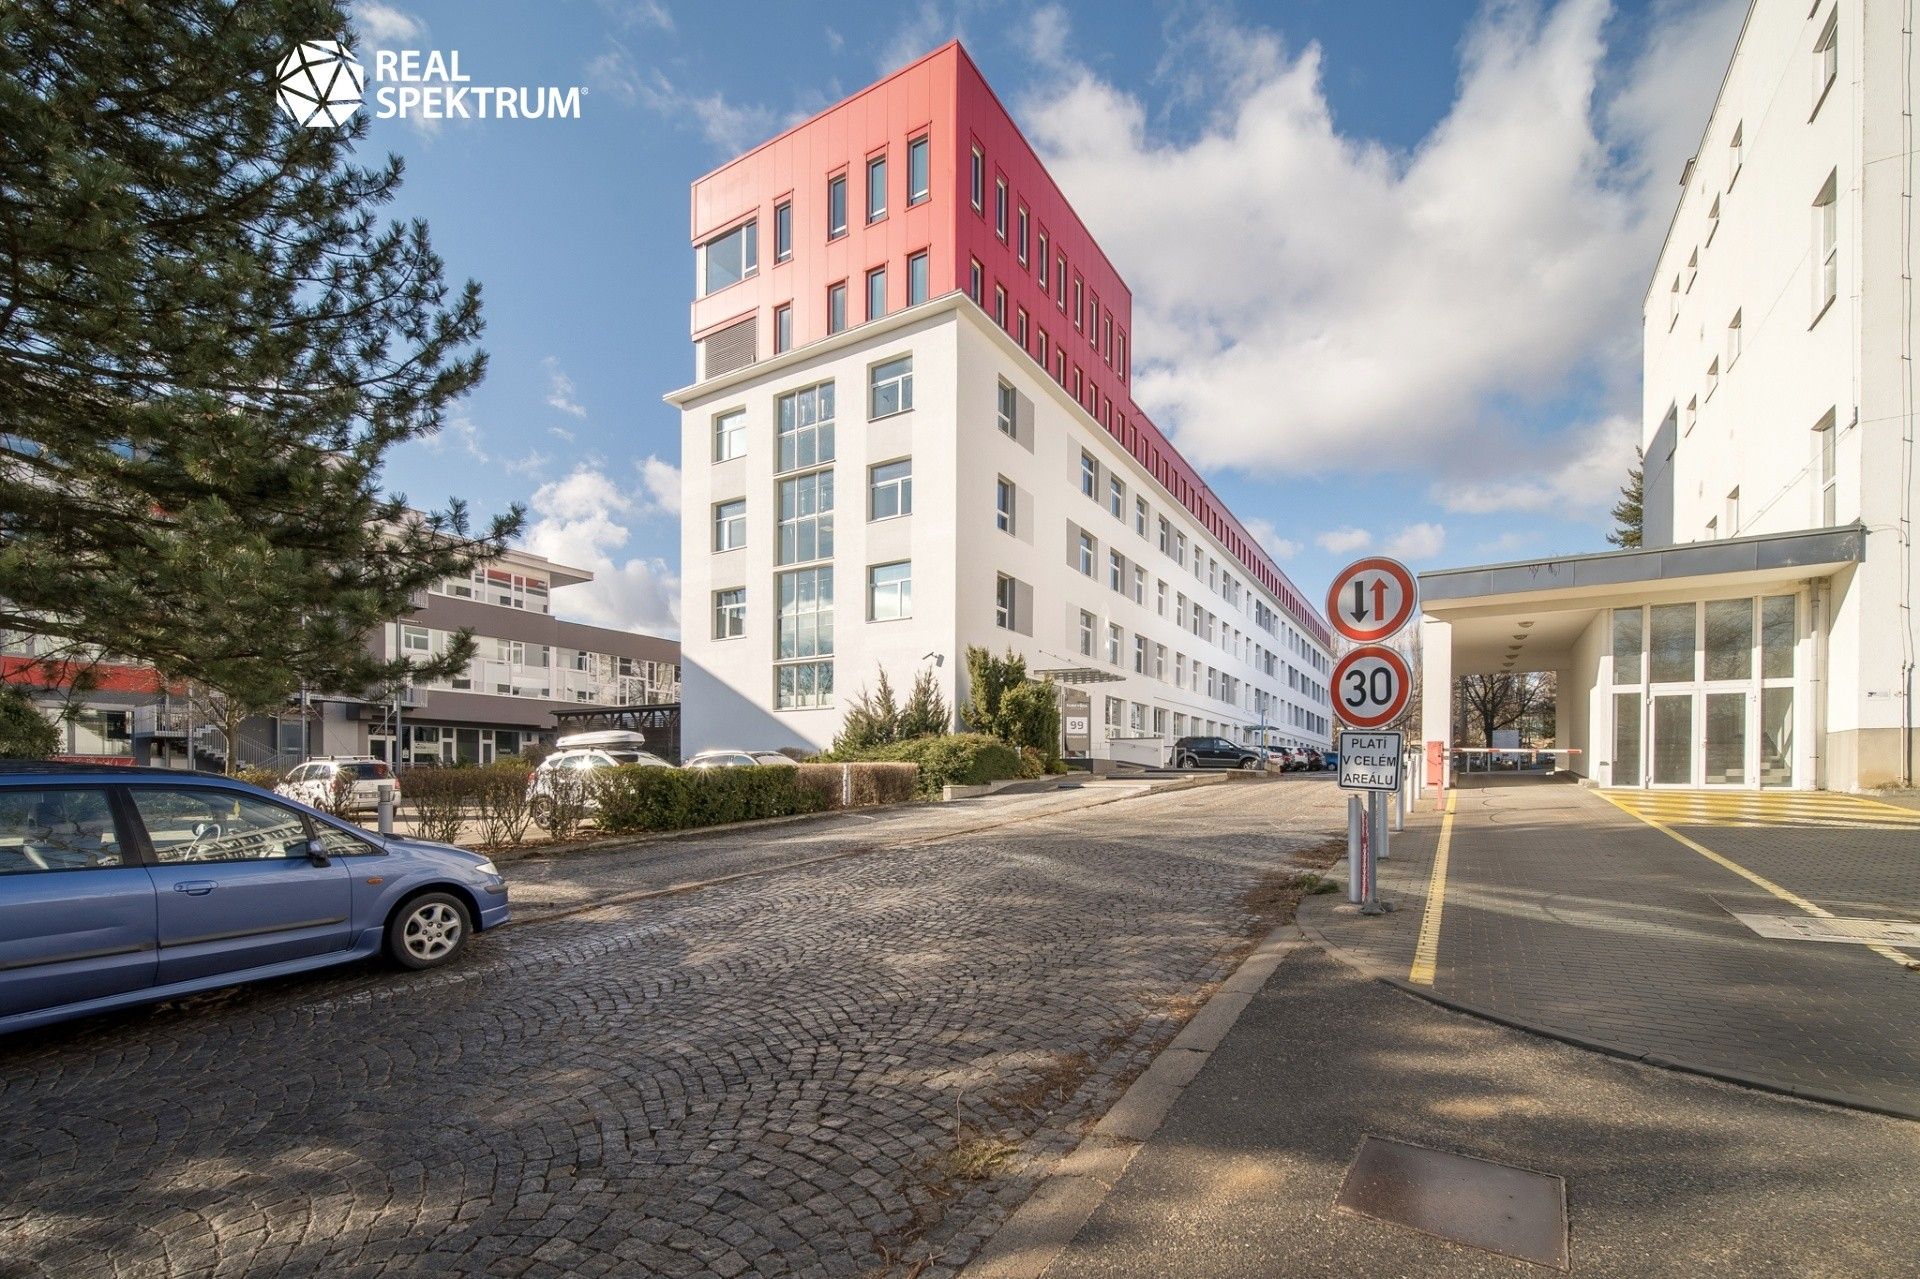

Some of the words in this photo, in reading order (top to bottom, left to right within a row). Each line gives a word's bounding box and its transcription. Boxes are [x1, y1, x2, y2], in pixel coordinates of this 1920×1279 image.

[1345, 666, 1392, 707] 30
[1070, 720, 1084, 730] 99
[1351, 736, 1387, 749] PLATÍ
[1342, 755, 1351, 765] V
[1354, 753, 1397, 767] CELÉM
[1343, 771, 1393, 786] AREÁLU
